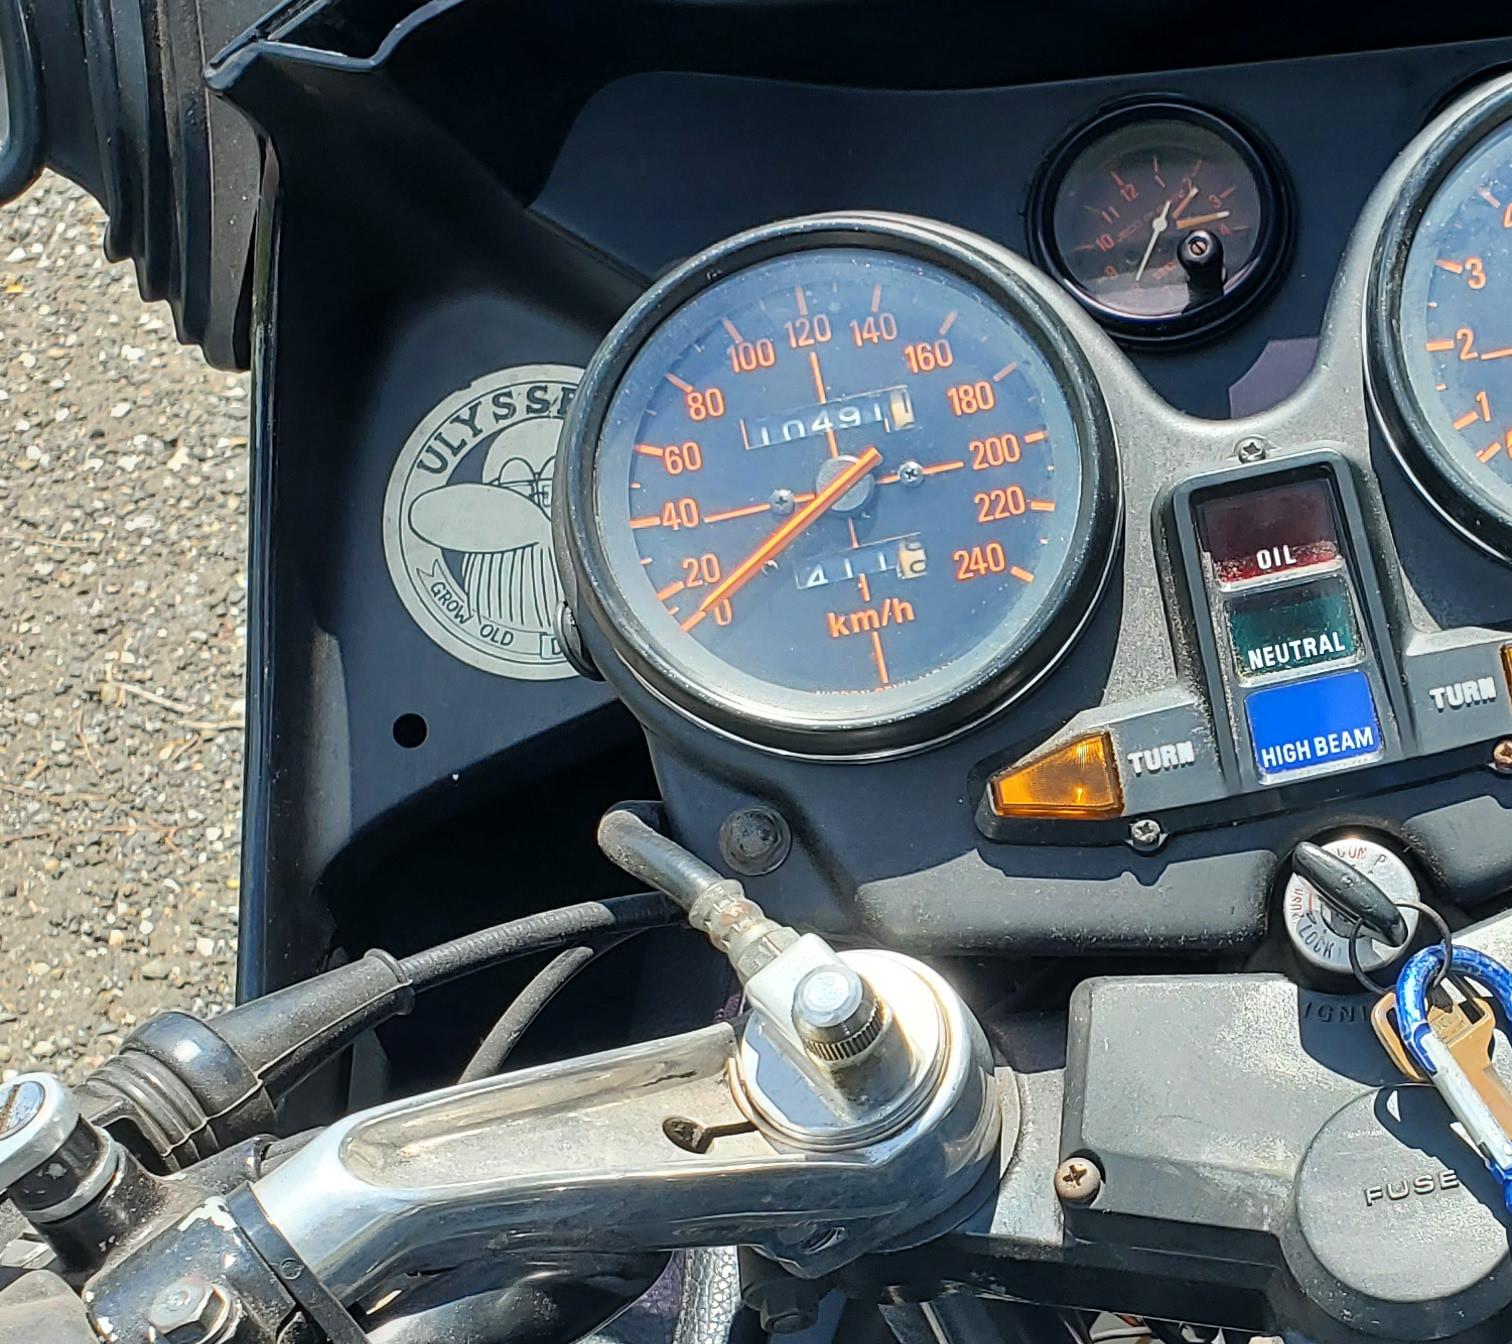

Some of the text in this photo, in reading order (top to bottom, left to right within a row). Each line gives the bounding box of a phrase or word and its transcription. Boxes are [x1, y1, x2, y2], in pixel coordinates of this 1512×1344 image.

[1095, 234, 1115, 252] 10
[1465, 257, 1485, 288] 3
[783, 312, 832, 348] 120
[849, 311, 899, 347] 140
[1456, 328, 1476, 360] 2
[727, 336, 776, 375] 100
[905, 337, 954, 375] 160
[684, 385, 725, 421] 80
[947, 381, 995, 415] 180
[1475, 392, 1490, 421] 1
[661, 442, 703, 475] 60
[970, 433, 1021, 469] 200
[660, 498, 700, 528] 40
[975, 485, 1027, 523] 220
[682, 554, 722, 588] 20
[953, 541, 1006, 581] 240
[1255, 547, 1297, 572] OIL
[429, 581, 473, 625] GROW
[479, 622, 514, 647] OLD
[713, 598, 732, 626] 0
[827, 596, 913, 640] km/h
[1248, 630, 1347, 672] NEUTRAL
[1429, 677, 1497, 712] TURN
[1127, 740, 1194, 775] TURN
[1260, 726, 1374, 770] HIGH BEAM
[1298, 922, 1335, 960] LOCK
[1304, 1001, 1368, 1024] IGNI
[1364, 1170, 1460, 1208] FUSE
